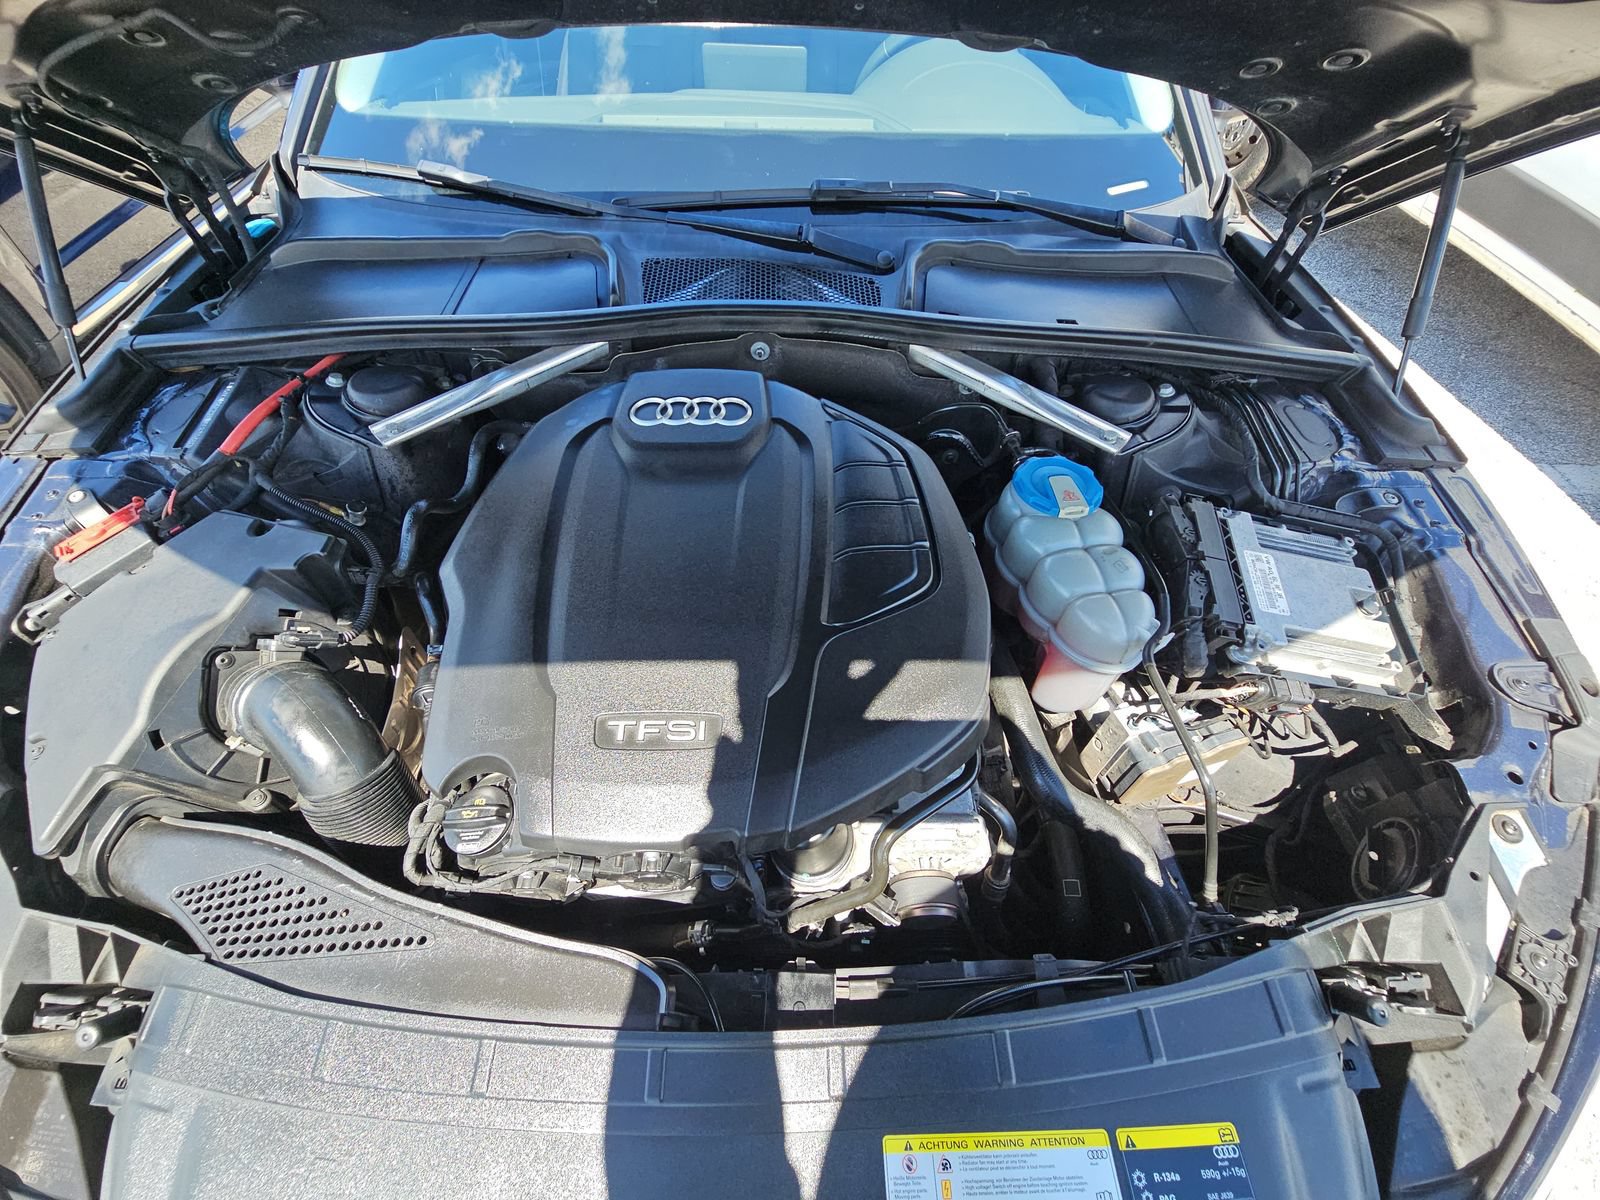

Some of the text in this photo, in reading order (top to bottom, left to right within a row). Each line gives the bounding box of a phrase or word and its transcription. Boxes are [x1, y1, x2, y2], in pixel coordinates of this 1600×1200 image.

[607, 720, 706, 742] TFSI
[918, 1136, 1086, 1150] ACHTUNG WARNING ATTENTION
[1153, 1171, 1181, 1183] R-134a
[1200, 1168, 1221, 1180] 590g
